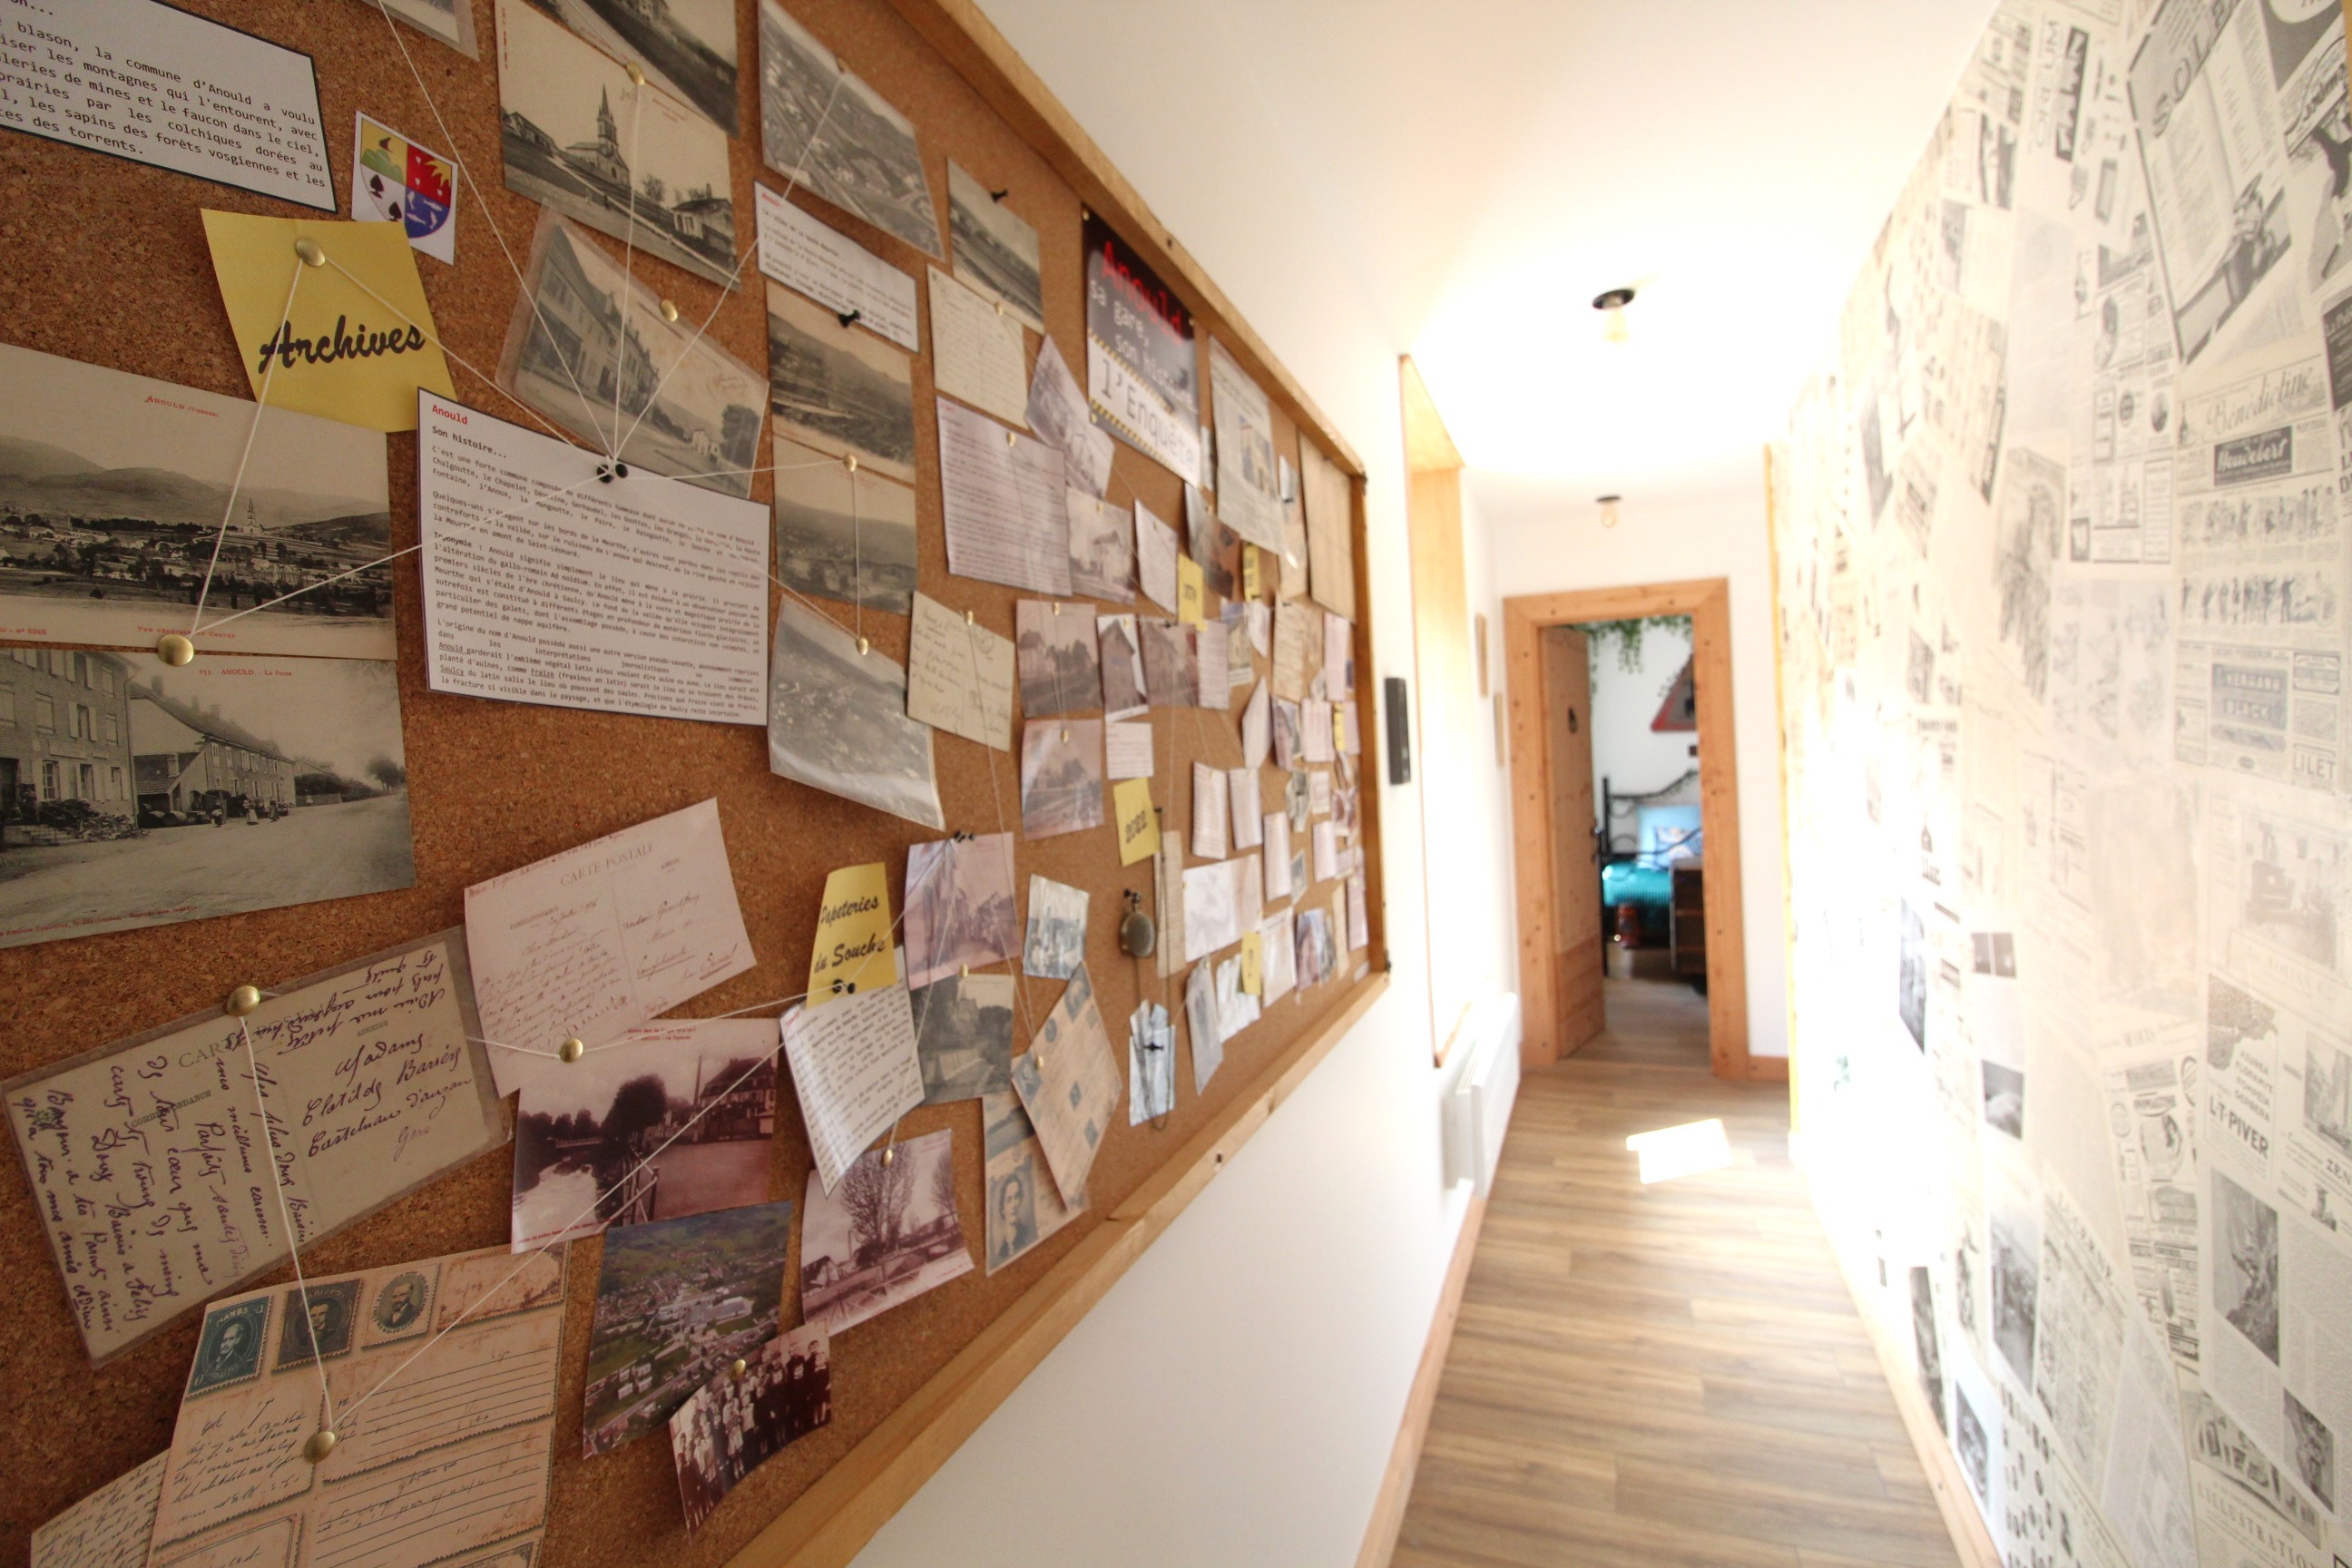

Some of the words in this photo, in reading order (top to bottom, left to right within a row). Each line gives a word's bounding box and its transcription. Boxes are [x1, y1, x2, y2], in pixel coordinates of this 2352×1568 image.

[17, 21, 79, 52] blason,
[95, 46, 112, 61] la
[126, 59, 181, 83] commune
[281, 109, 315, 124] voulu
[47, 48, 74, 65] les
[83, 63, 157, 92] montagnes
[167, 88, 189, 102] qui
[198, 95, 282, 132] l'entourent,
[291, 127, 317, 141] avec
[33, 117, 60, 132] des
[68, 126, 142, 154] torrents.
[64, 73, 82, 85] de
[89, 82, 131, 100] mines
[138, 96, 153, 107] et
[161, 101, 176, 113] le
[182, 108, 227, 129] faucon
[233, 123, 261, 139] dans
[268, 132, 281, 145] le
[287, 141, 318, 157] ciel,
[87, 98, 112, 111] par
[128, 107, 152, 123] les
[168, 122, 241, 149] colchiques
[255, 145, 297, 164] dorées
[309, 162, 322, 172] au
[29, 96, 55, 113] les
[65, 110, 115, 130] sapins
[123, 124, 148, 138] des
[155, 132, 201, 153] forêts
[209, 149, 279, 174] vosgiennes
[286, 171, 299, 181] et
[306, 174, 325, 187] les
[258, 314, 426, 374] Archives
[432, 405, 467, 425] Anould
[432, 426, 447, 438] Son
[453, 433, 506, 458] histoire...
[489, 546, 514, 558] Anould
[439, 642, 464, 654] Anould
[440, 664, 465, 677] Saulcy
